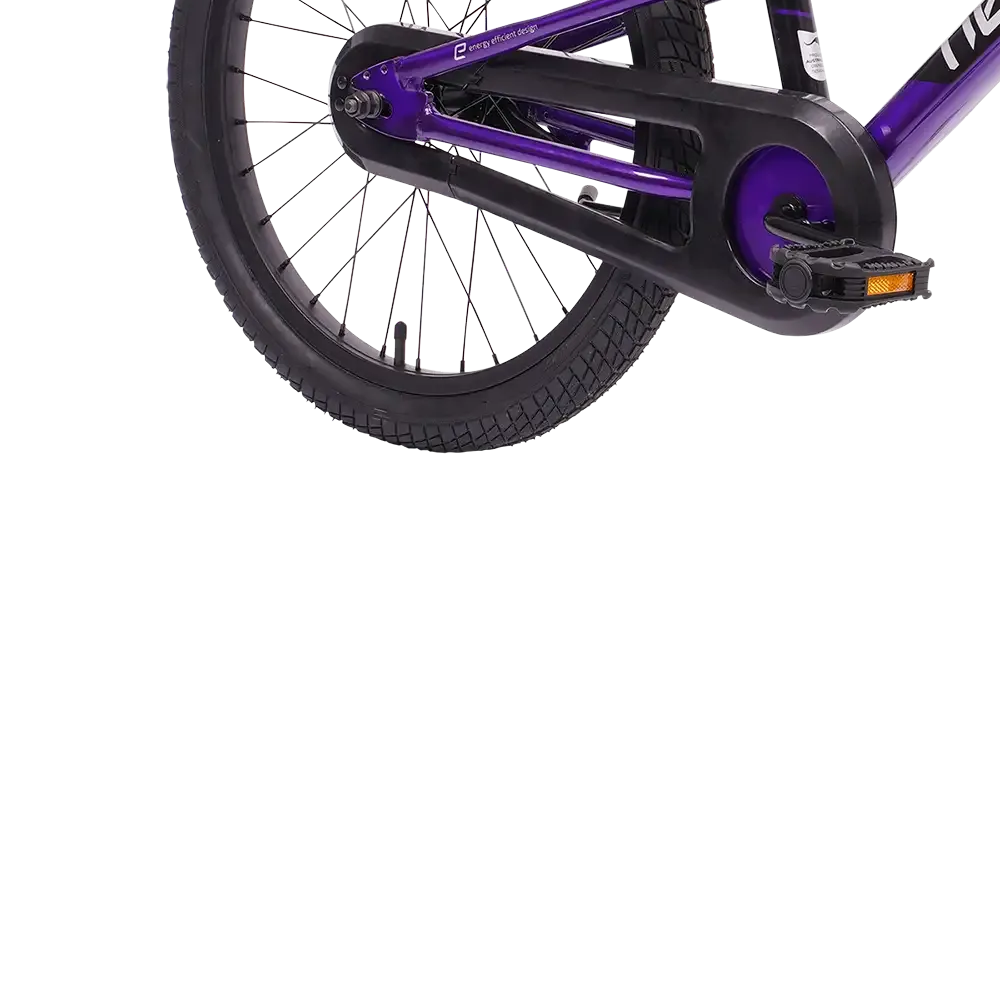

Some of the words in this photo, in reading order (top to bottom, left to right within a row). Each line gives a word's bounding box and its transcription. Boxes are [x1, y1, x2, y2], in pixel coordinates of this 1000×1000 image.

[468, 40, 491, 52] energy
[491, 30, 517, 45] efficient
[517, 24, 539, 37] design
